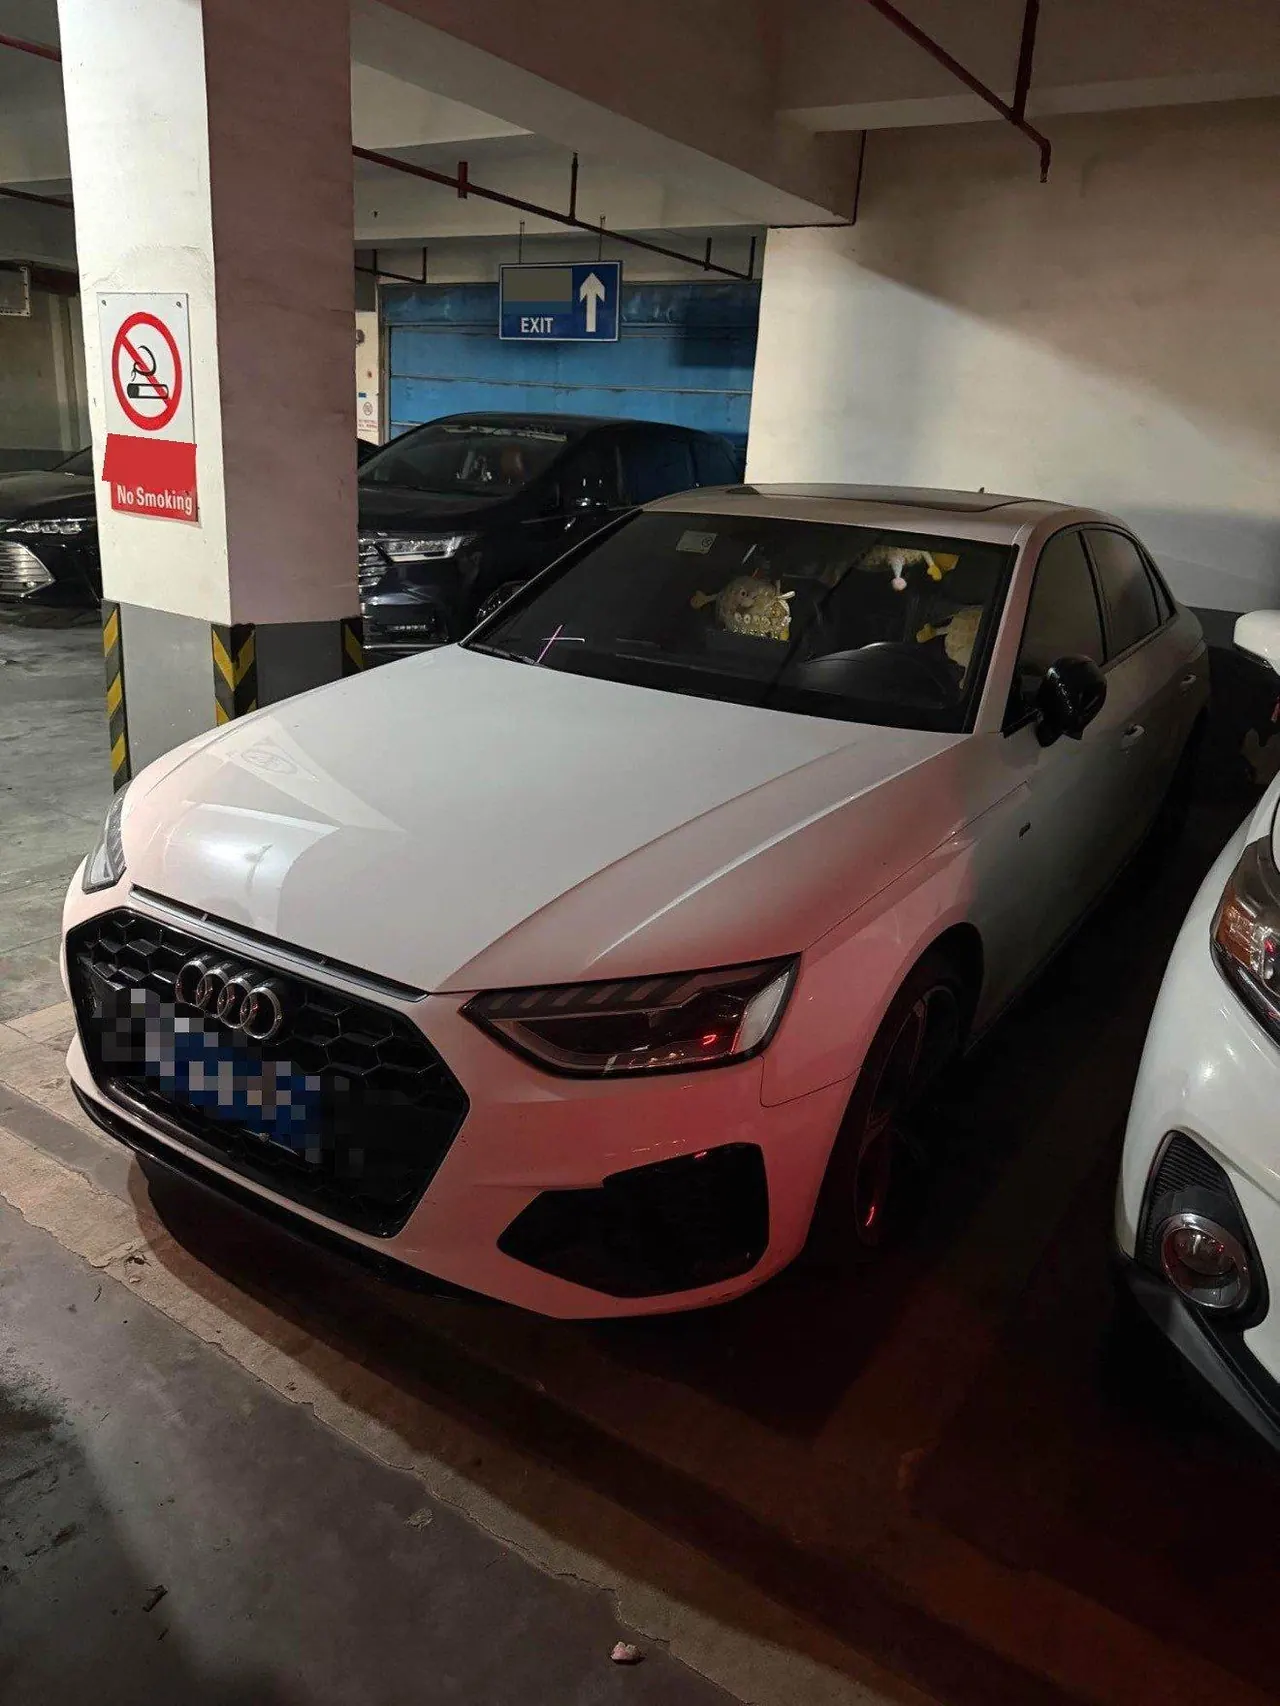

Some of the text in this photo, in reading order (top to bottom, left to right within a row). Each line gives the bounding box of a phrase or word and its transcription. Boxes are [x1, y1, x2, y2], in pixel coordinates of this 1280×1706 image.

[521, 317, 554, 333] EXIT
[117, 484, 193, 516] No Smoking
